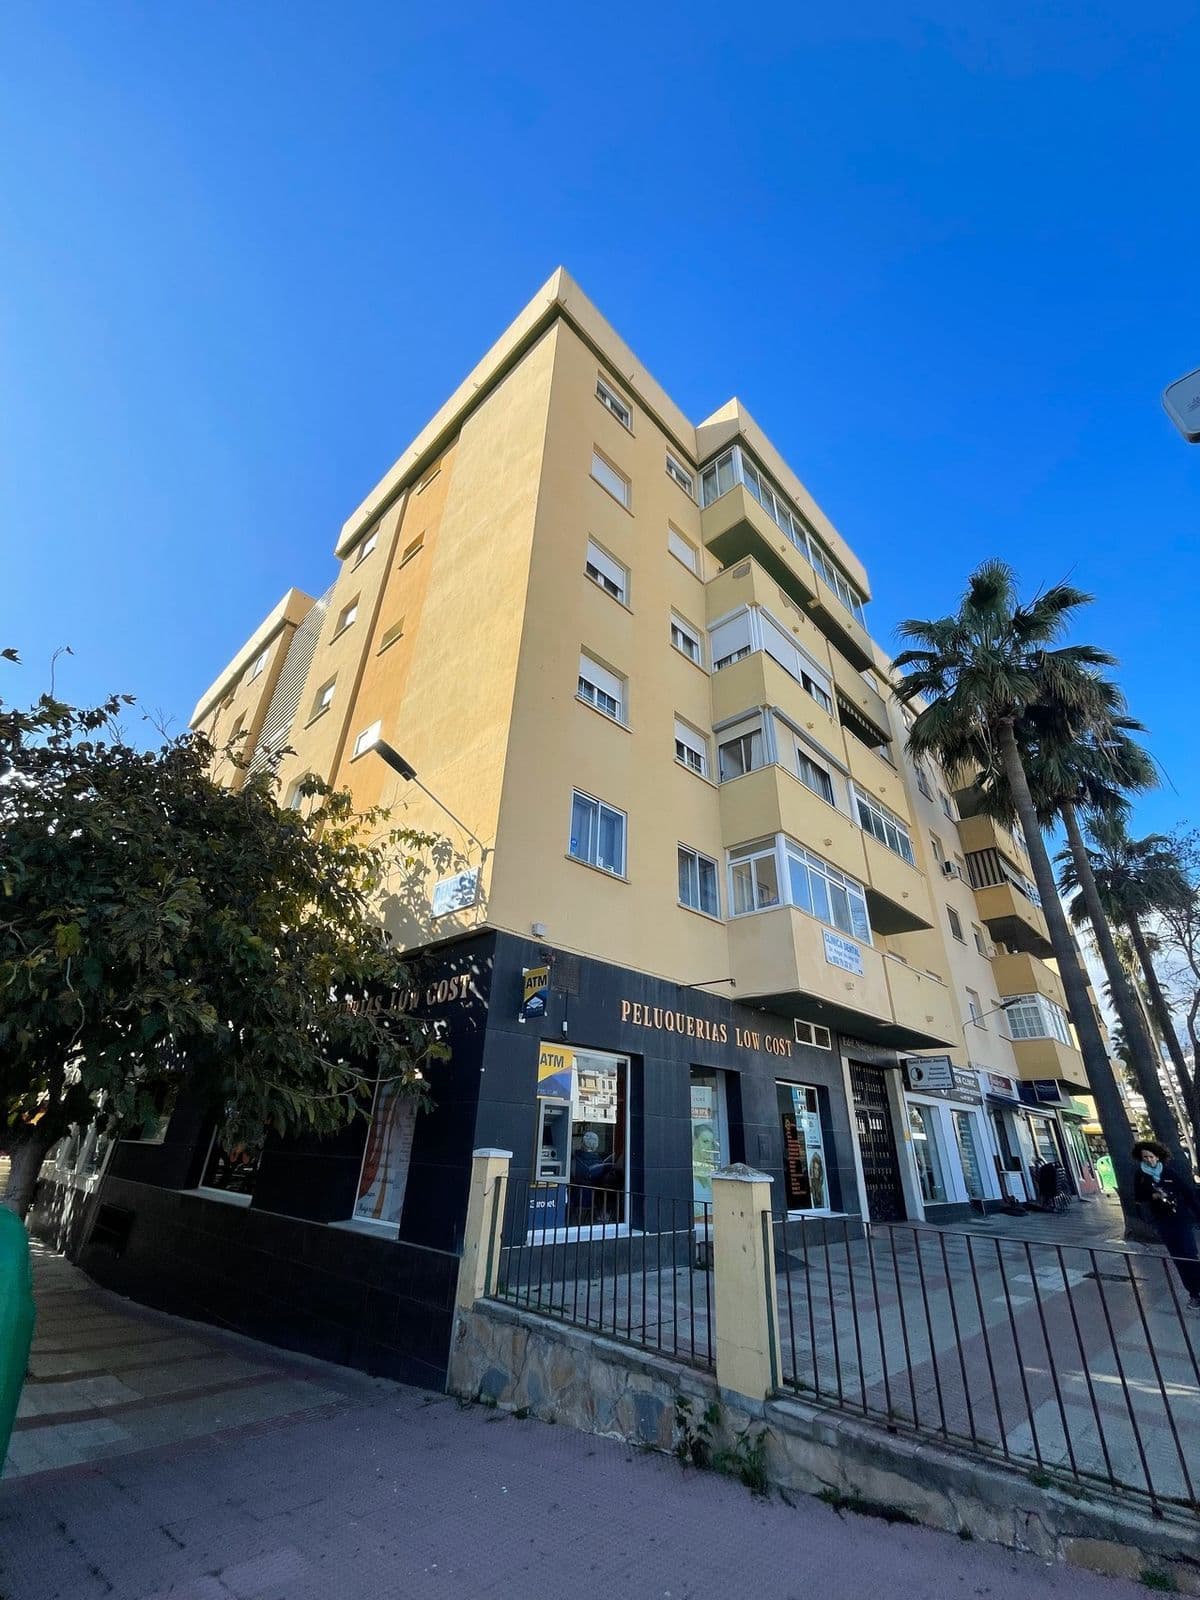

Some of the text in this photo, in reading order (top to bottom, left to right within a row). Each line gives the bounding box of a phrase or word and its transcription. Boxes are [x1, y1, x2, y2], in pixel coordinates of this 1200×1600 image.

[426, 974, 471, 1006] COST
[526, 974, 547, 988] ATM
[621, 1000, 792, 1057] PELUQUERIAS LOW COST
[540, 1053, 564, 1068] ATM
